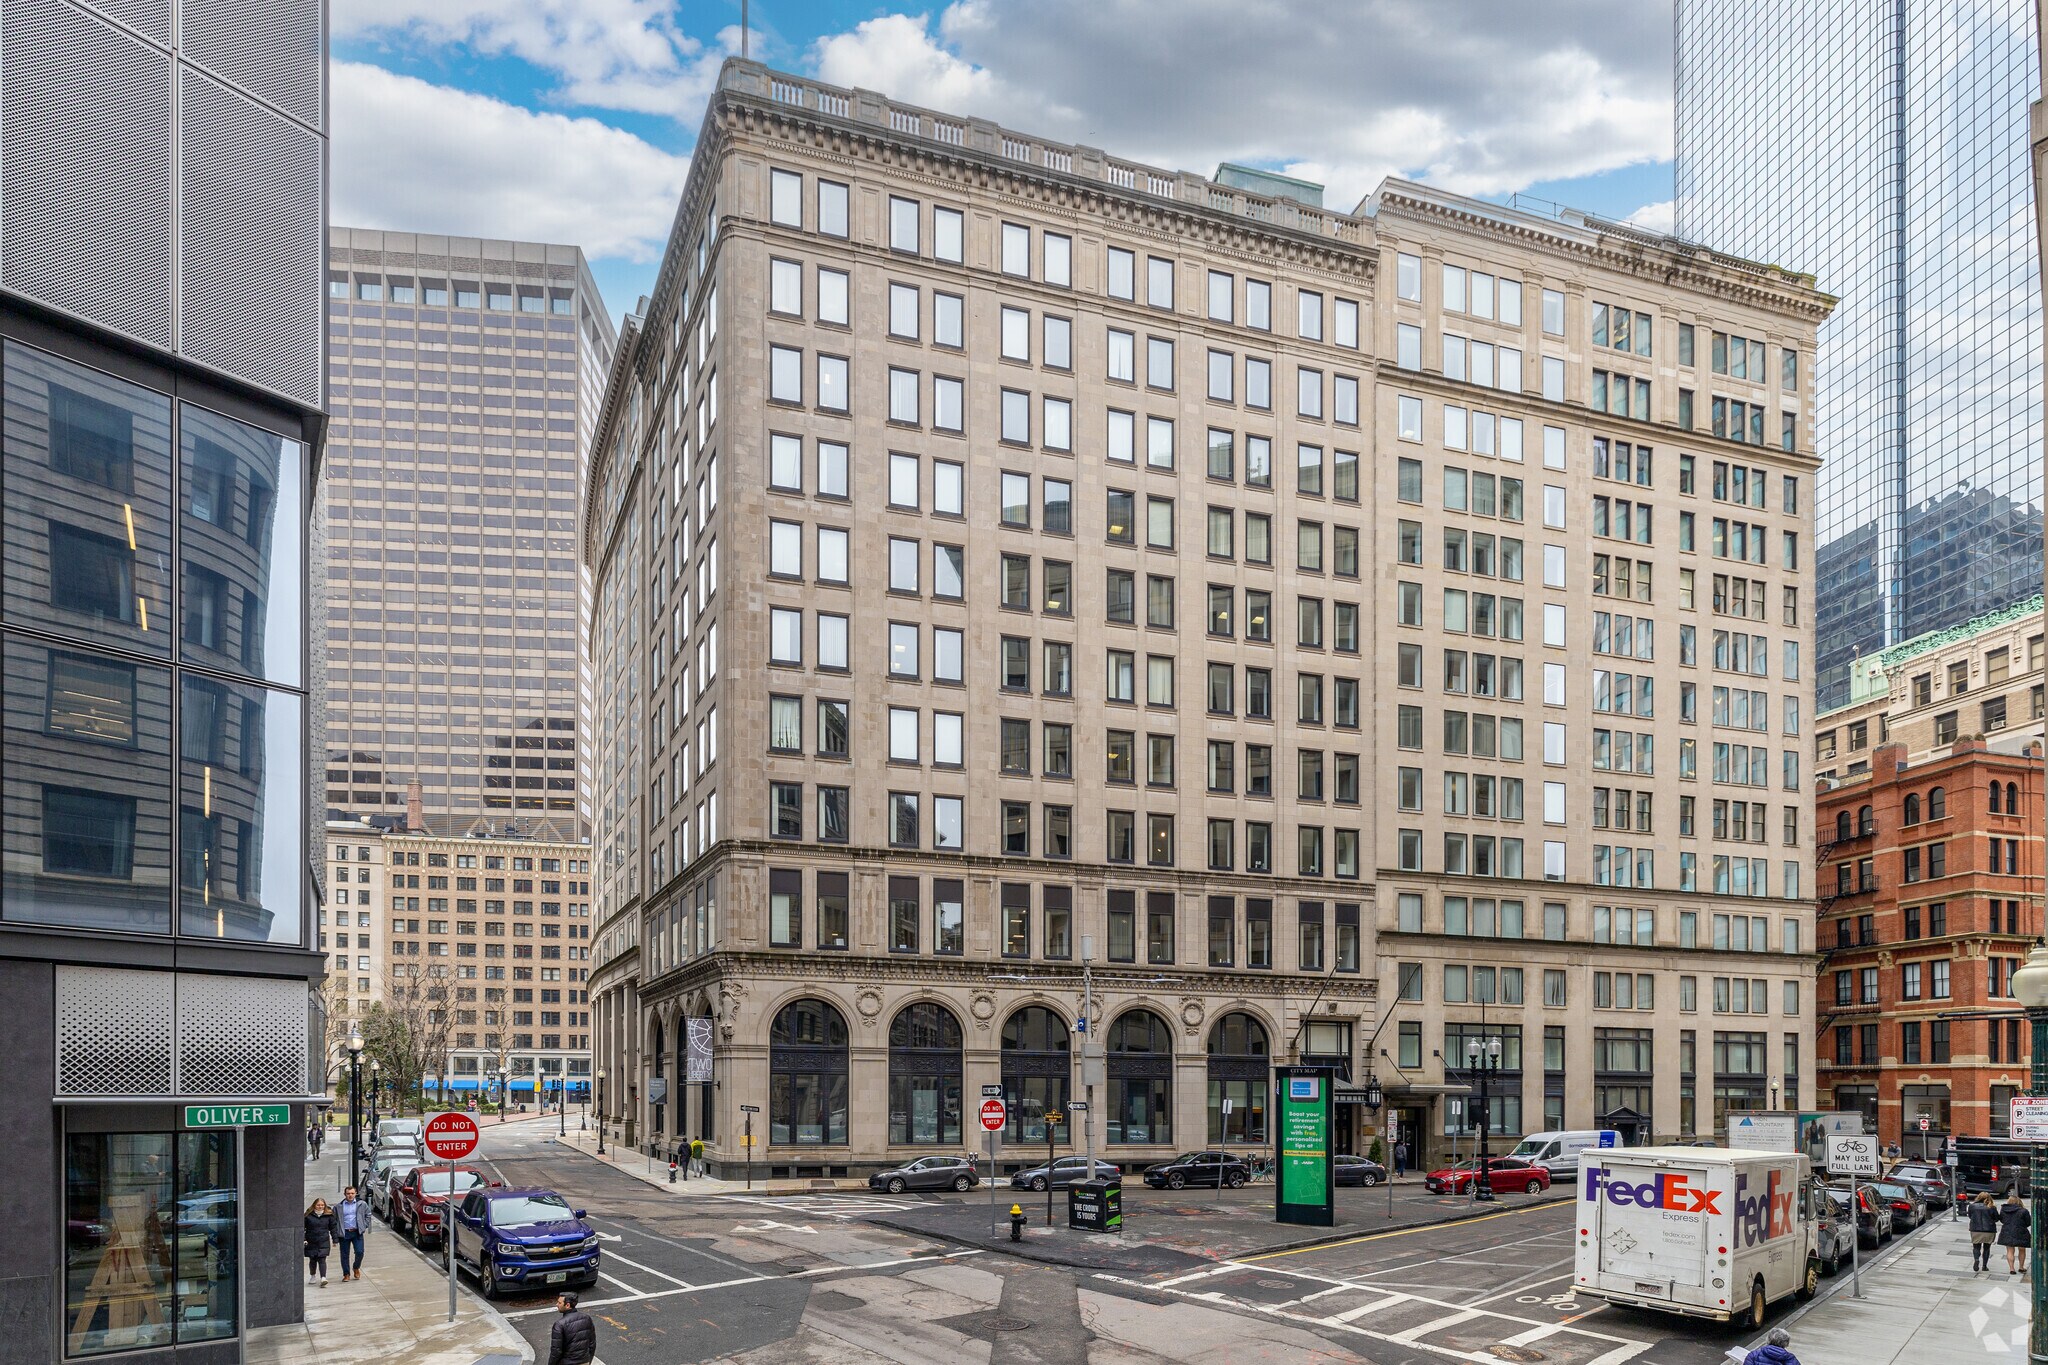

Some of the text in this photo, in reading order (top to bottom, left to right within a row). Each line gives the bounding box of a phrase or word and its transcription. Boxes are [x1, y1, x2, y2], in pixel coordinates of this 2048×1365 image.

[688, 1058, 712, 1071] TWO
[197, 1108, 279, 1124] OLIVER ST
[434, 1122, 471, 1130] DO NOT
[1586, 1167, 1722, 1215] FedEx
[1074, 1203, 1099, 1213] THE CROWN
[1734, 1169, 1793, 1249] FedEx
[1082, 1212, 1096, 1221] YOURS
[1662, 1212, 1700, 1223] Express
[1662, 1231, 1696, 1239] fedex.com
[1768, 1250, 1783, 1264] Express
